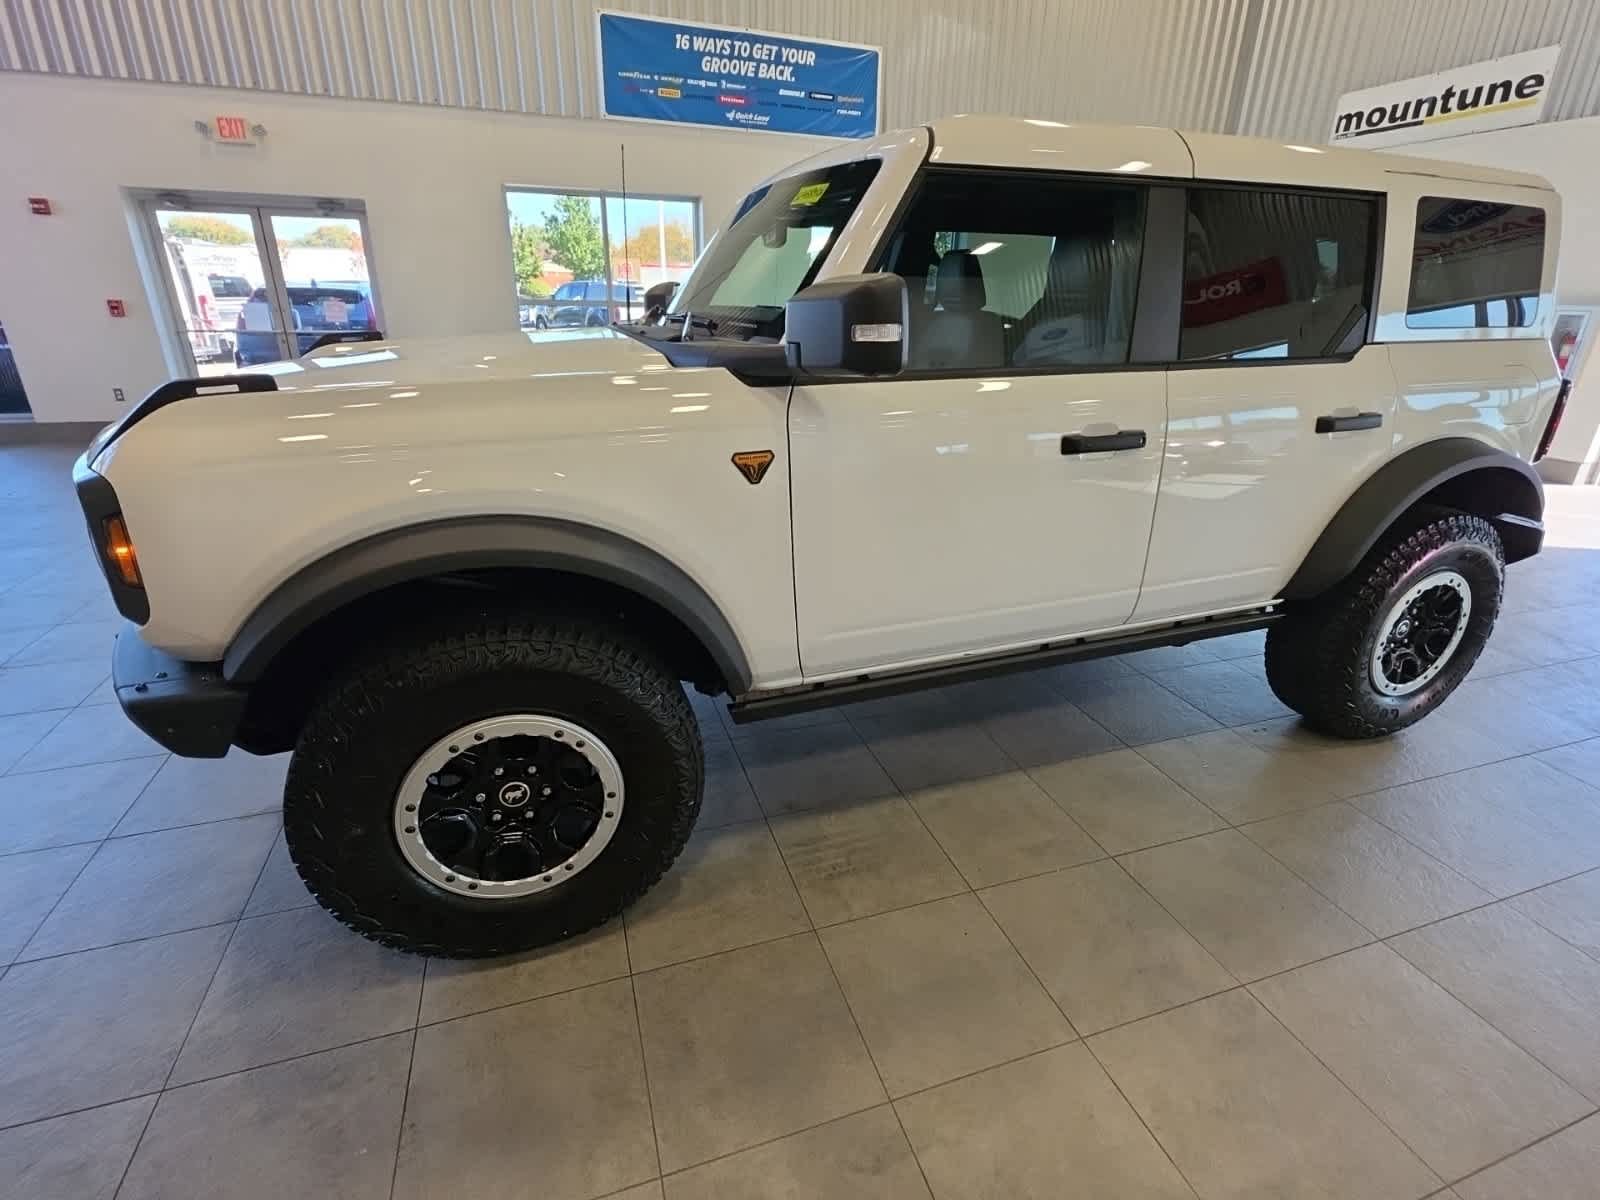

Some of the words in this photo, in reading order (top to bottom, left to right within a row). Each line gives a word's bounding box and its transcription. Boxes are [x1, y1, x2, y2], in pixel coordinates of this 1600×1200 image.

[675, 33, 690, 50] 16
[693, 36, 731, 55] WAYS
[733, 40, 750, 58] TO
[752, 43, 778, 61] GET
[781, 47, 816, 66] YOUR
[701, 56, 757, 77] GROOVE
[758, 63, 796, 82] BACK.
[1335, 73, 1545, 134] mountune
[216, 116, 247, 139] EXIT
